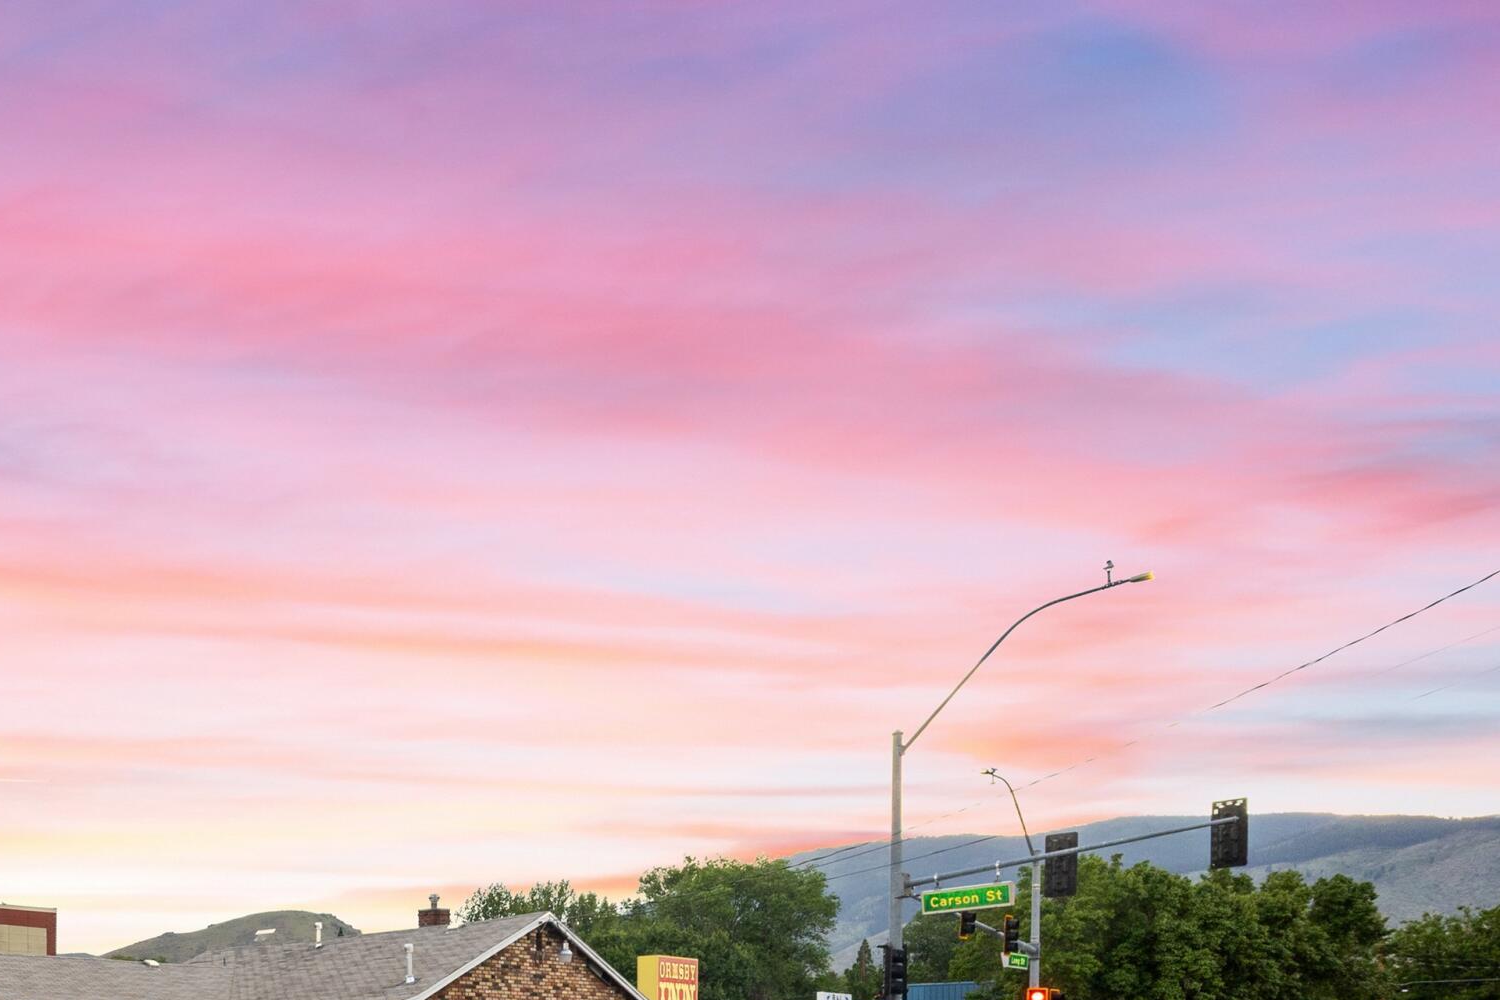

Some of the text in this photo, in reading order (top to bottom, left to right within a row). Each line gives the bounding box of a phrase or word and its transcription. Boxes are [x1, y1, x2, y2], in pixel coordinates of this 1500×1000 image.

[930, 889, 1002, 908] Carson St
[660, 961, 696, 981] ORMSBY
